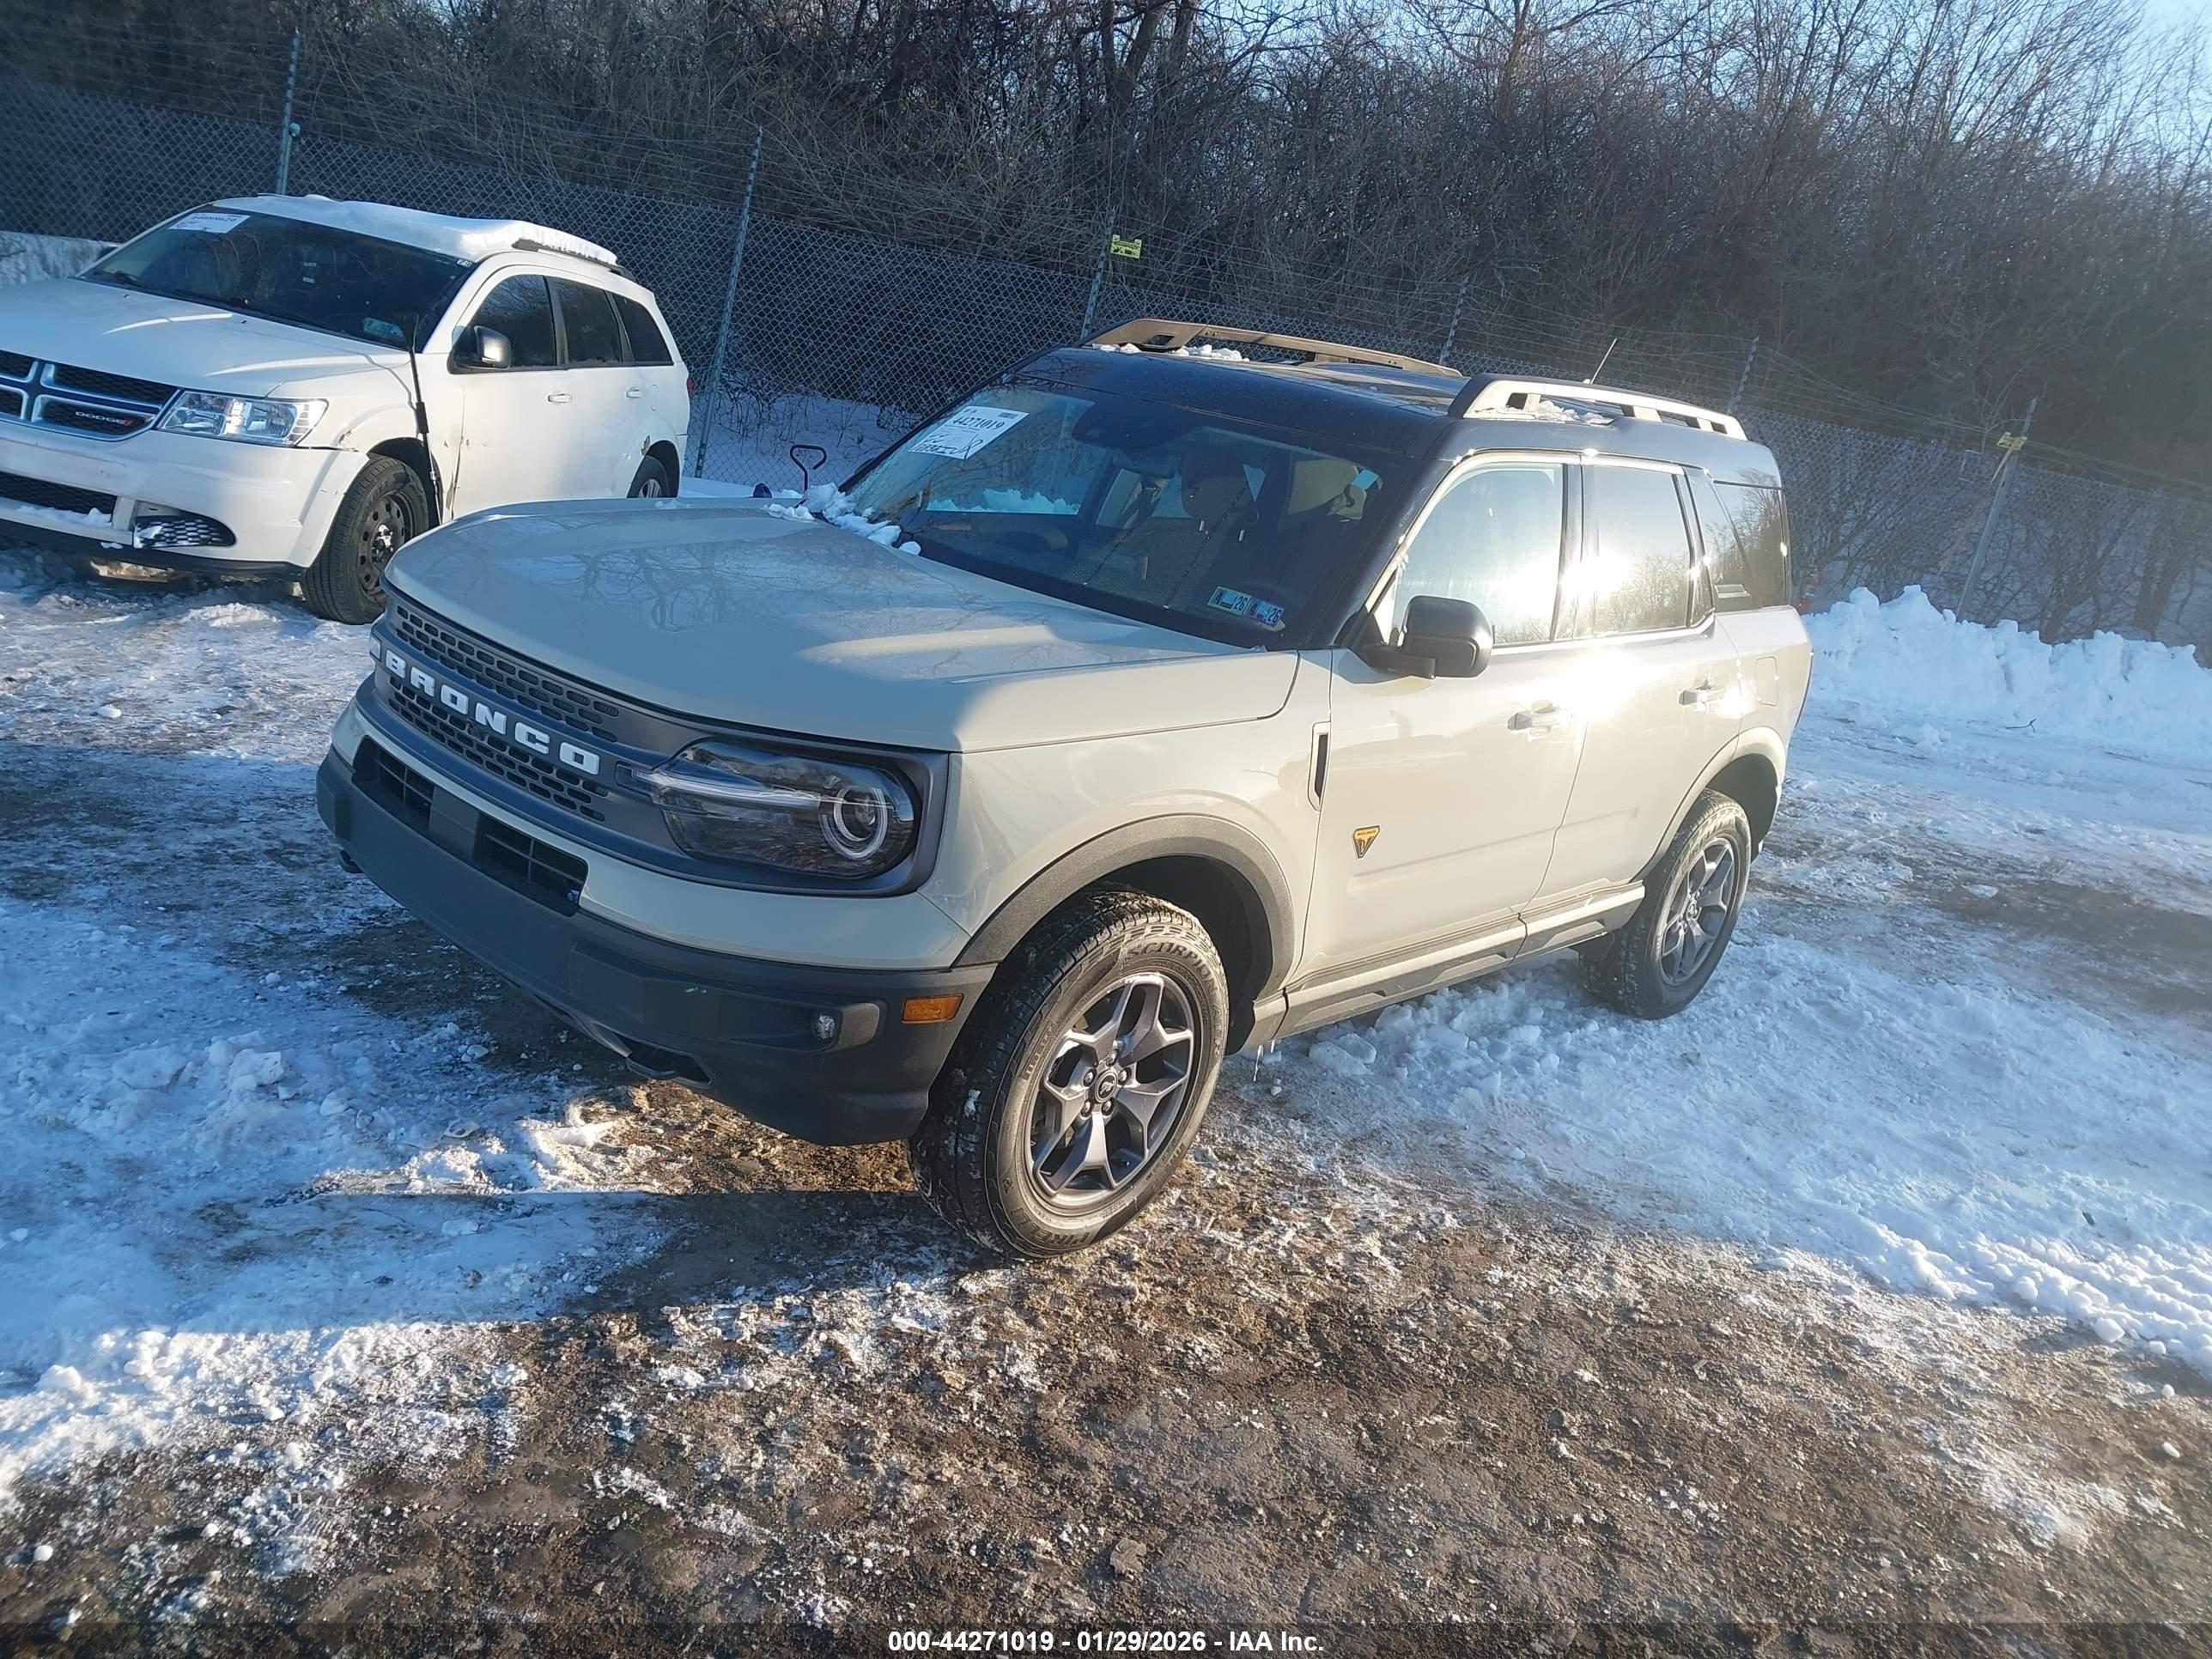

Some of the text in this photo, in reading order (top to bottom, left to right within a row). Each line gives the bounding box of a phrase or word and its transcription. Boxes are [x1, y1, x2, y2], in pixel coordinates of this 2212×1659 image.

[75, 411, 125, 424] DODGE
[952, 416, 1006, 430] 44271019
[1234, 596, 1249, 611] 26
[1268, 608, 1282, 623] 26
[385, 649, 600, 775] BRONCO
[1127, 942, 1218, 996] SCORPION
[1011, 1207, 1091, 1247] PIRELLI
